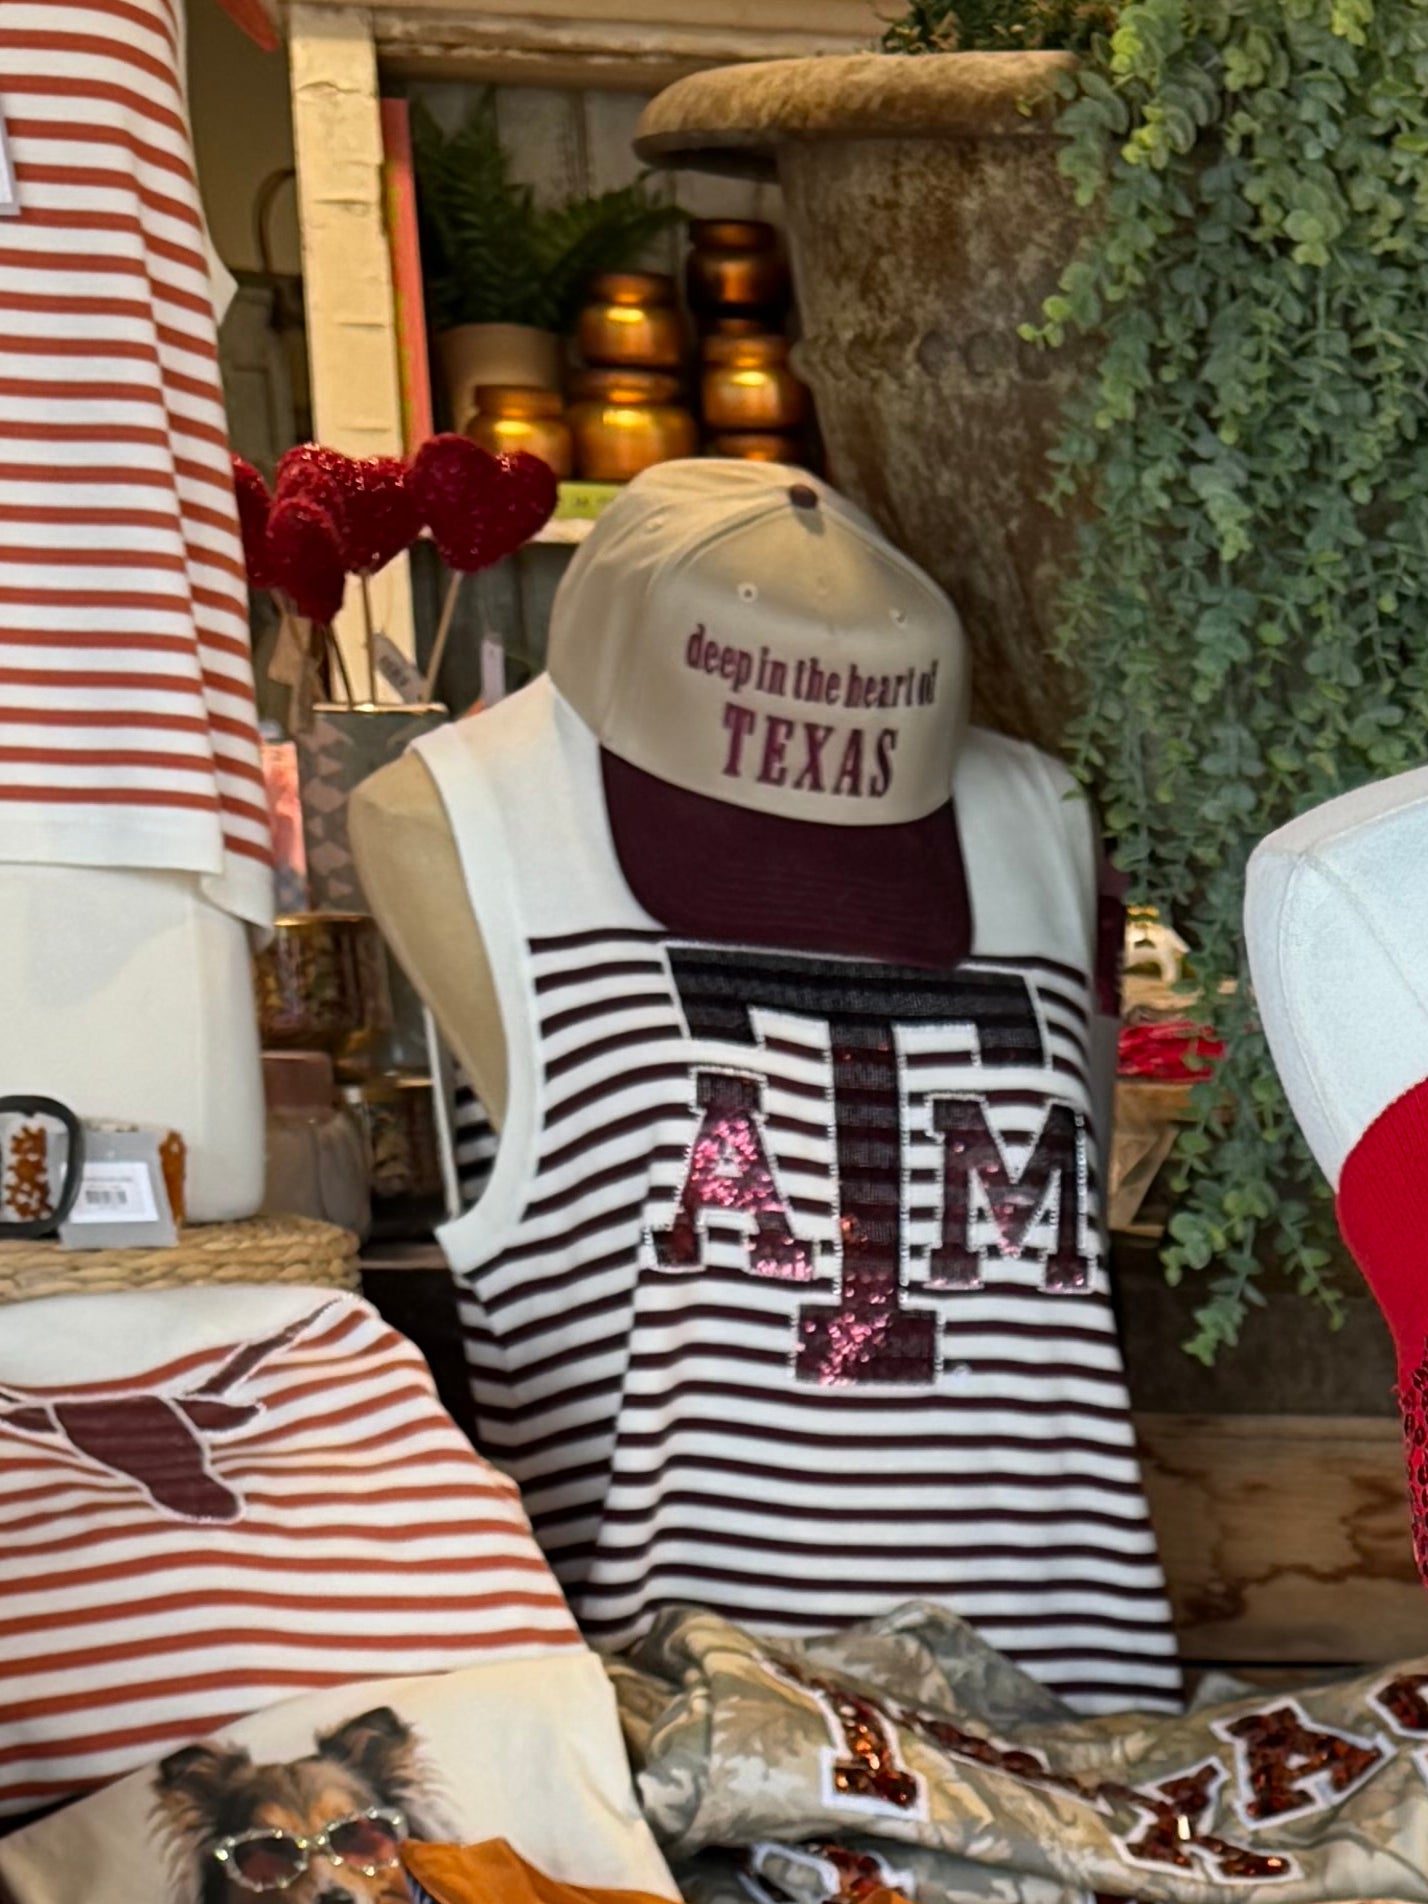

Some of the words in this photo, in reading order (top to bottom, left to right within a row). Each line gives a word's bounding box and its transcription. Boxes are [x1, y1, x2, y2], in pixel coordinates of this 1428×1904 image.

[685, 623, 753, 693] deep
[756, 646, 787, 696] in
[794, 657, 841, 705] the
[843, 663, 916, 708] heart
[721, 702, 898, 798] TEXAS
